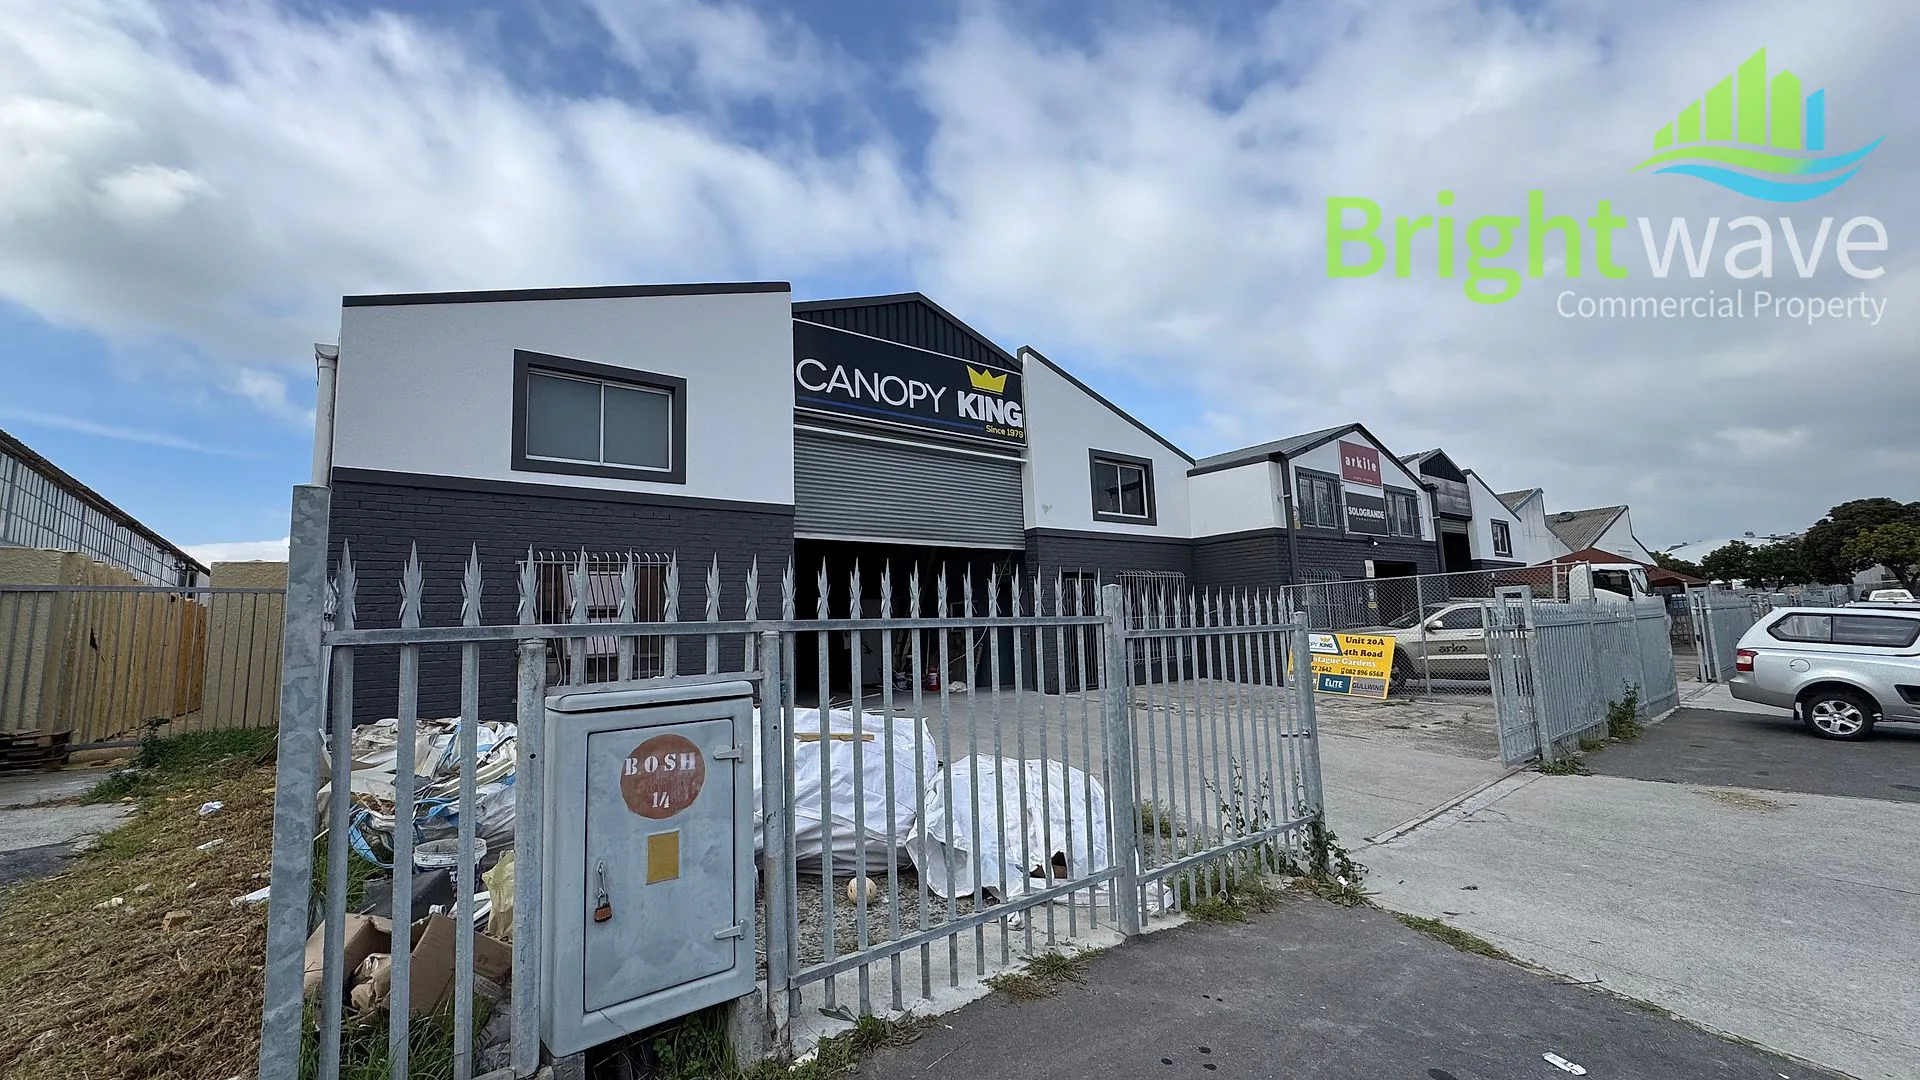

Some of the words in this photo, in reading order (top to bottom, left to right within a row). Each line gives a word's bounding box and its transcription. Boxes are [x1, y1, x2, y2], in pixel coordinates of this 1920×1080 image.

[796, 358, 947, 413] CANOPY
[957, 390, 1023, 428] KING
[986, 424, 1006, 436] Since
[1006, 428, 1024, 439] 1979
[1345, 456, 1377, 472] arkile
[1348, 506, 1385, 519] SOLOGRANDE
[1345, 636, 1365, 645] Unit
[1367, 638, 1385, 646] 20A
[1343, 648, 1358, 657] 4th
[1360, 650, 1383, 658] Road
[1341, 658, 1376, 668] Gardens
[1368, 670, 1384, 678] 6568
[1325, 678, 1344, 688] ELITE
[1352, 682, 1384, 692] GULLWING
[624, 751, 697, 776] BOSH
[652, 791, 671, 809] 14
